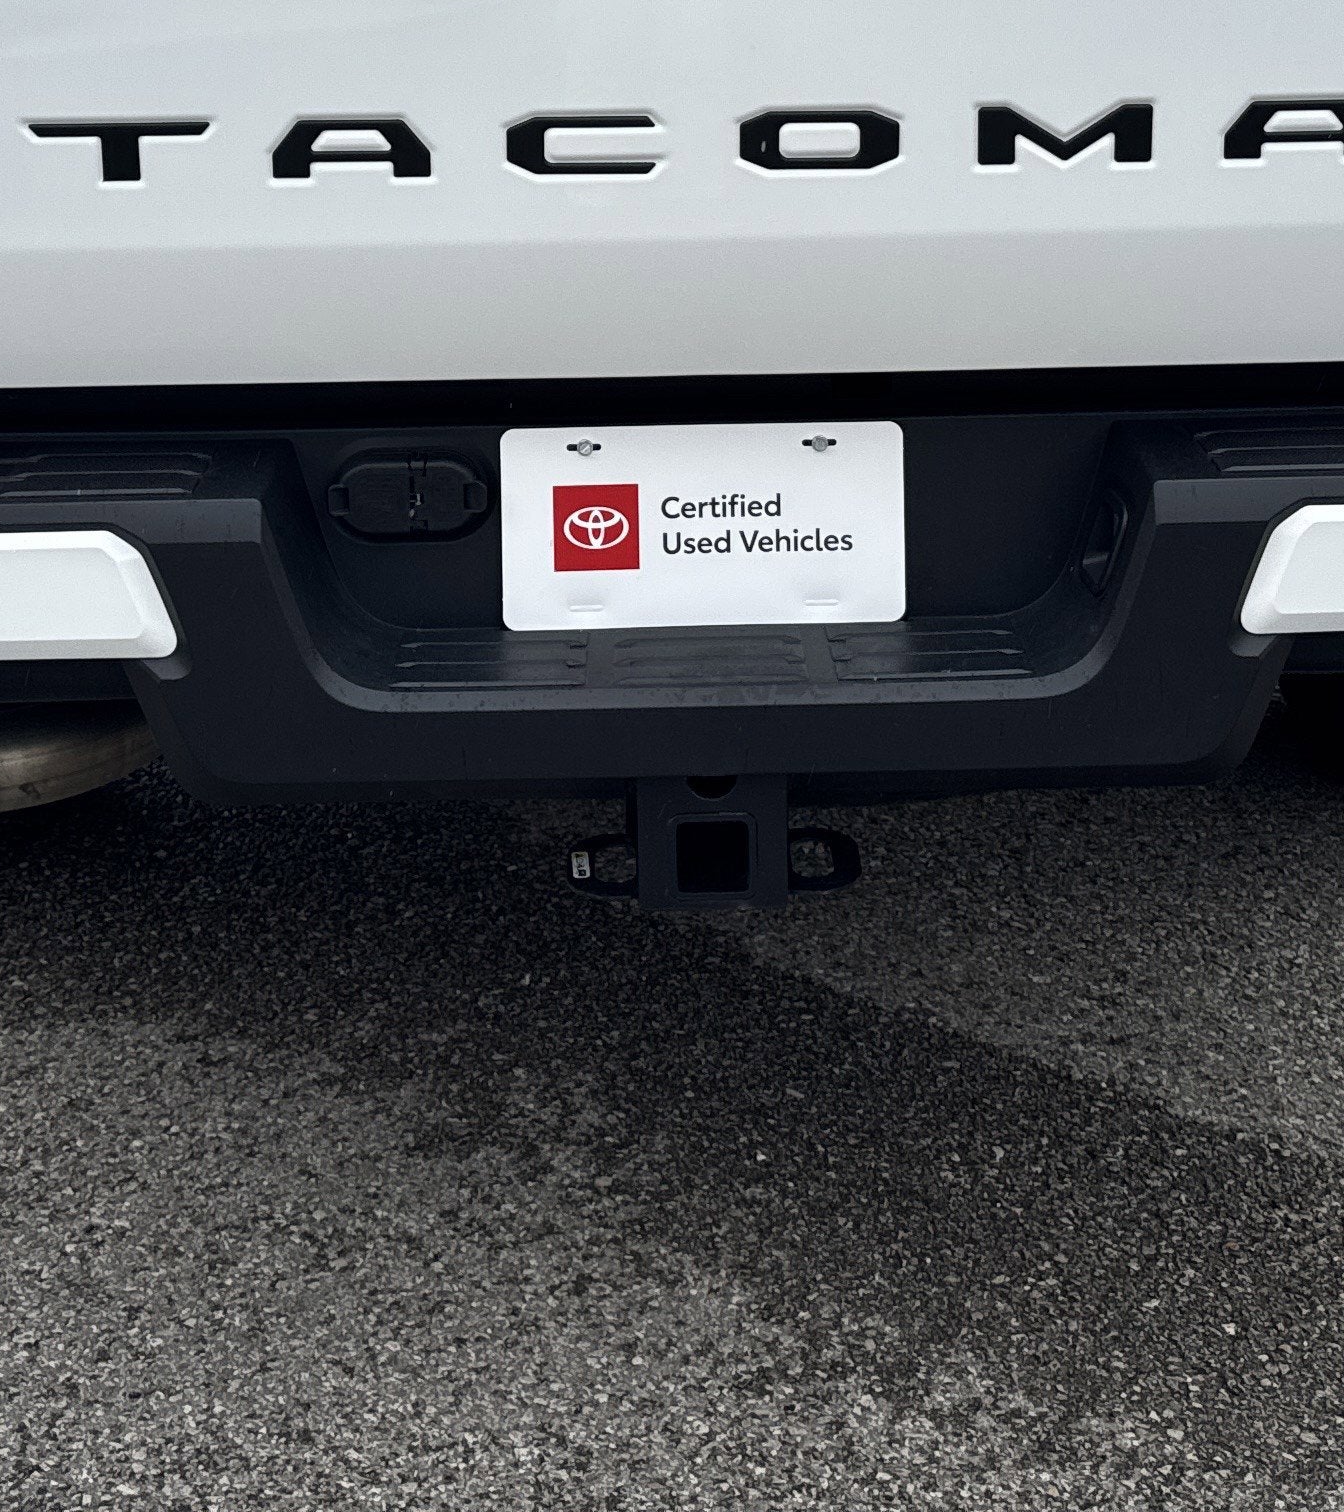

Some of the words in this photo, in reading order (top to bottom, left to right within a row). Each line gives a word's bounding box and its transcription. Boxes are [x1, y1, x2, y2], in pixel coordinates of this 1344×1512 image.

[660, 493, 782, 519] Certified
[661, 529, 732, 555] Used
[739, 528, 854, 554] Vehicles
